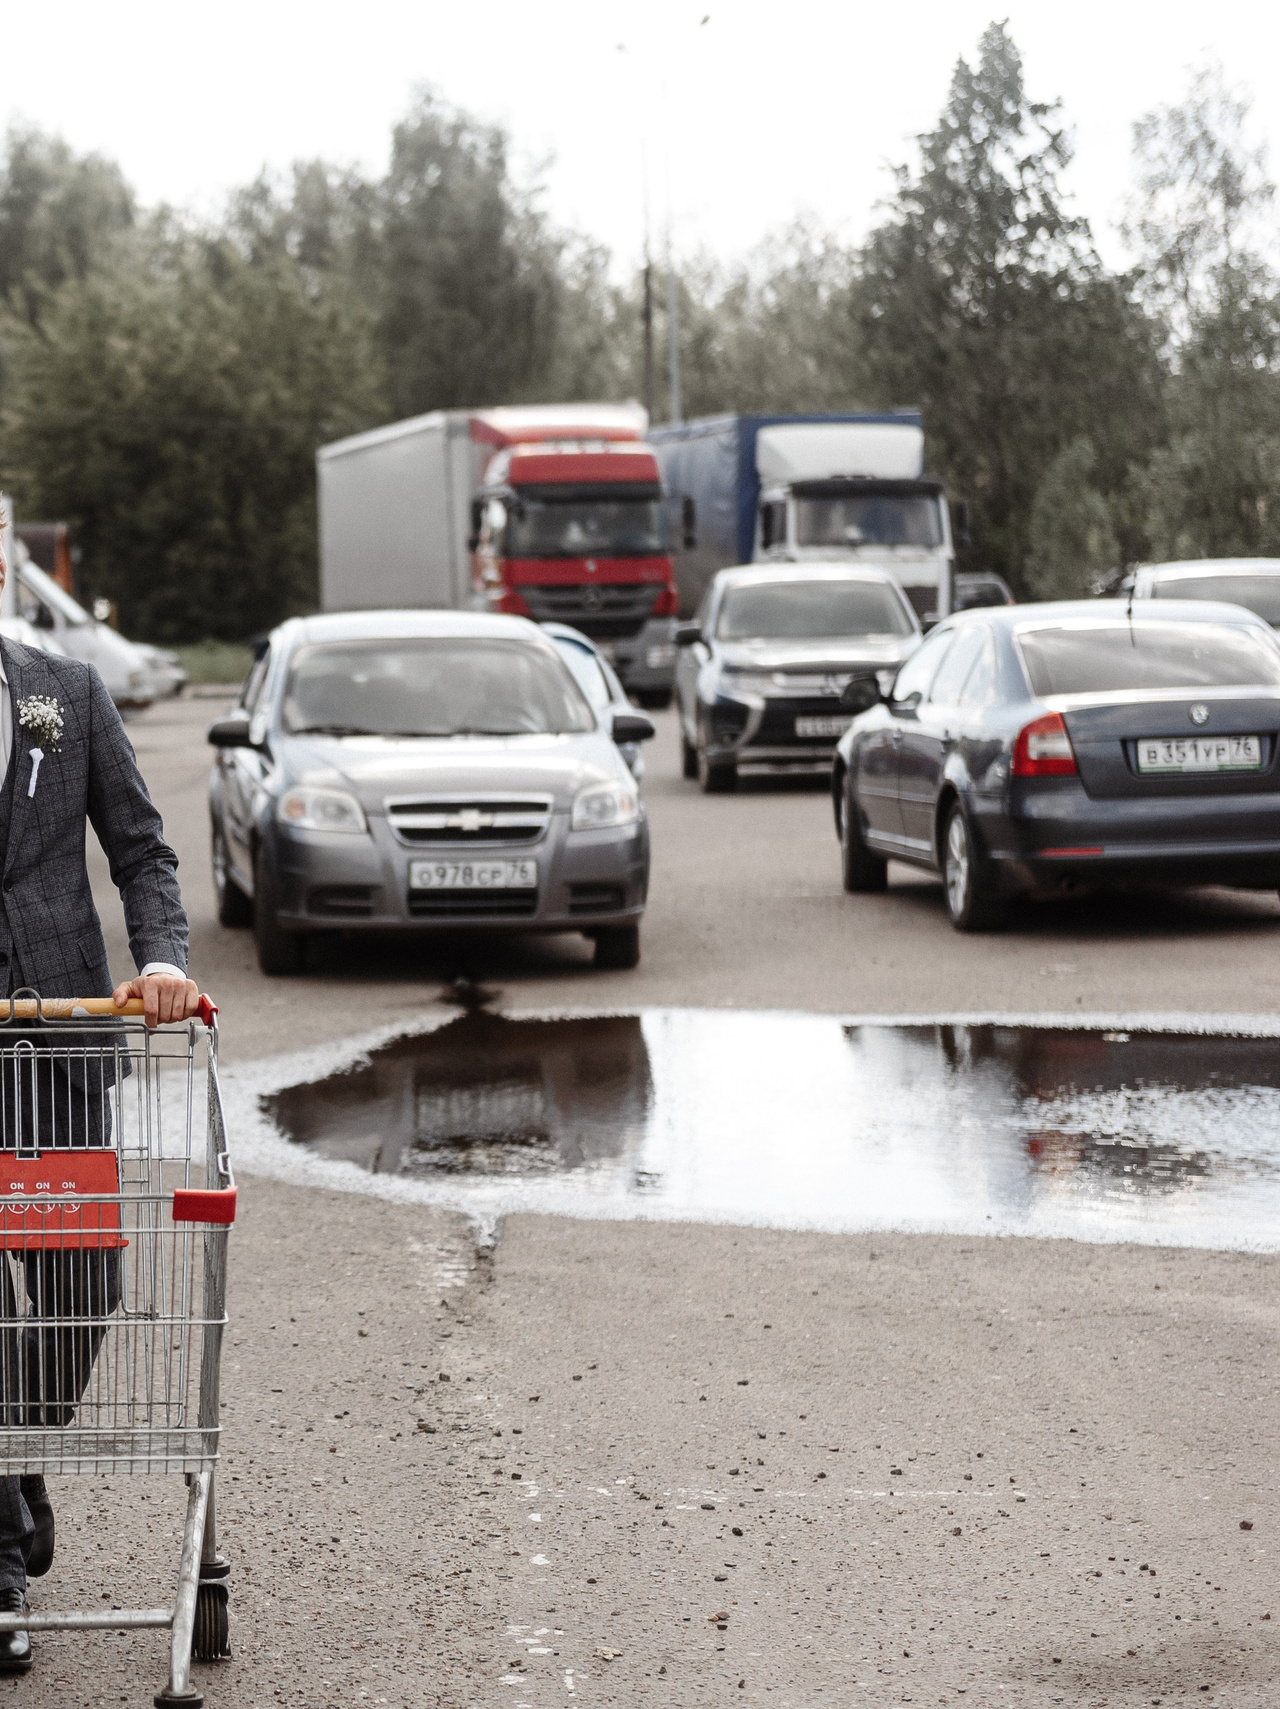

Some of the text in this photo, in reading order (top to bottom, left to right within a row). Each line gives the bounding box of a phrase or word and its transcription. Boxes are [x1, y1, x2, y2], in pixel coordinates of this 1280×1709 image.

[10, 1182, 24, 1190] NO
[35, 1182, 51, 1190] NO
[61, 1181, 76, 1189] NO
